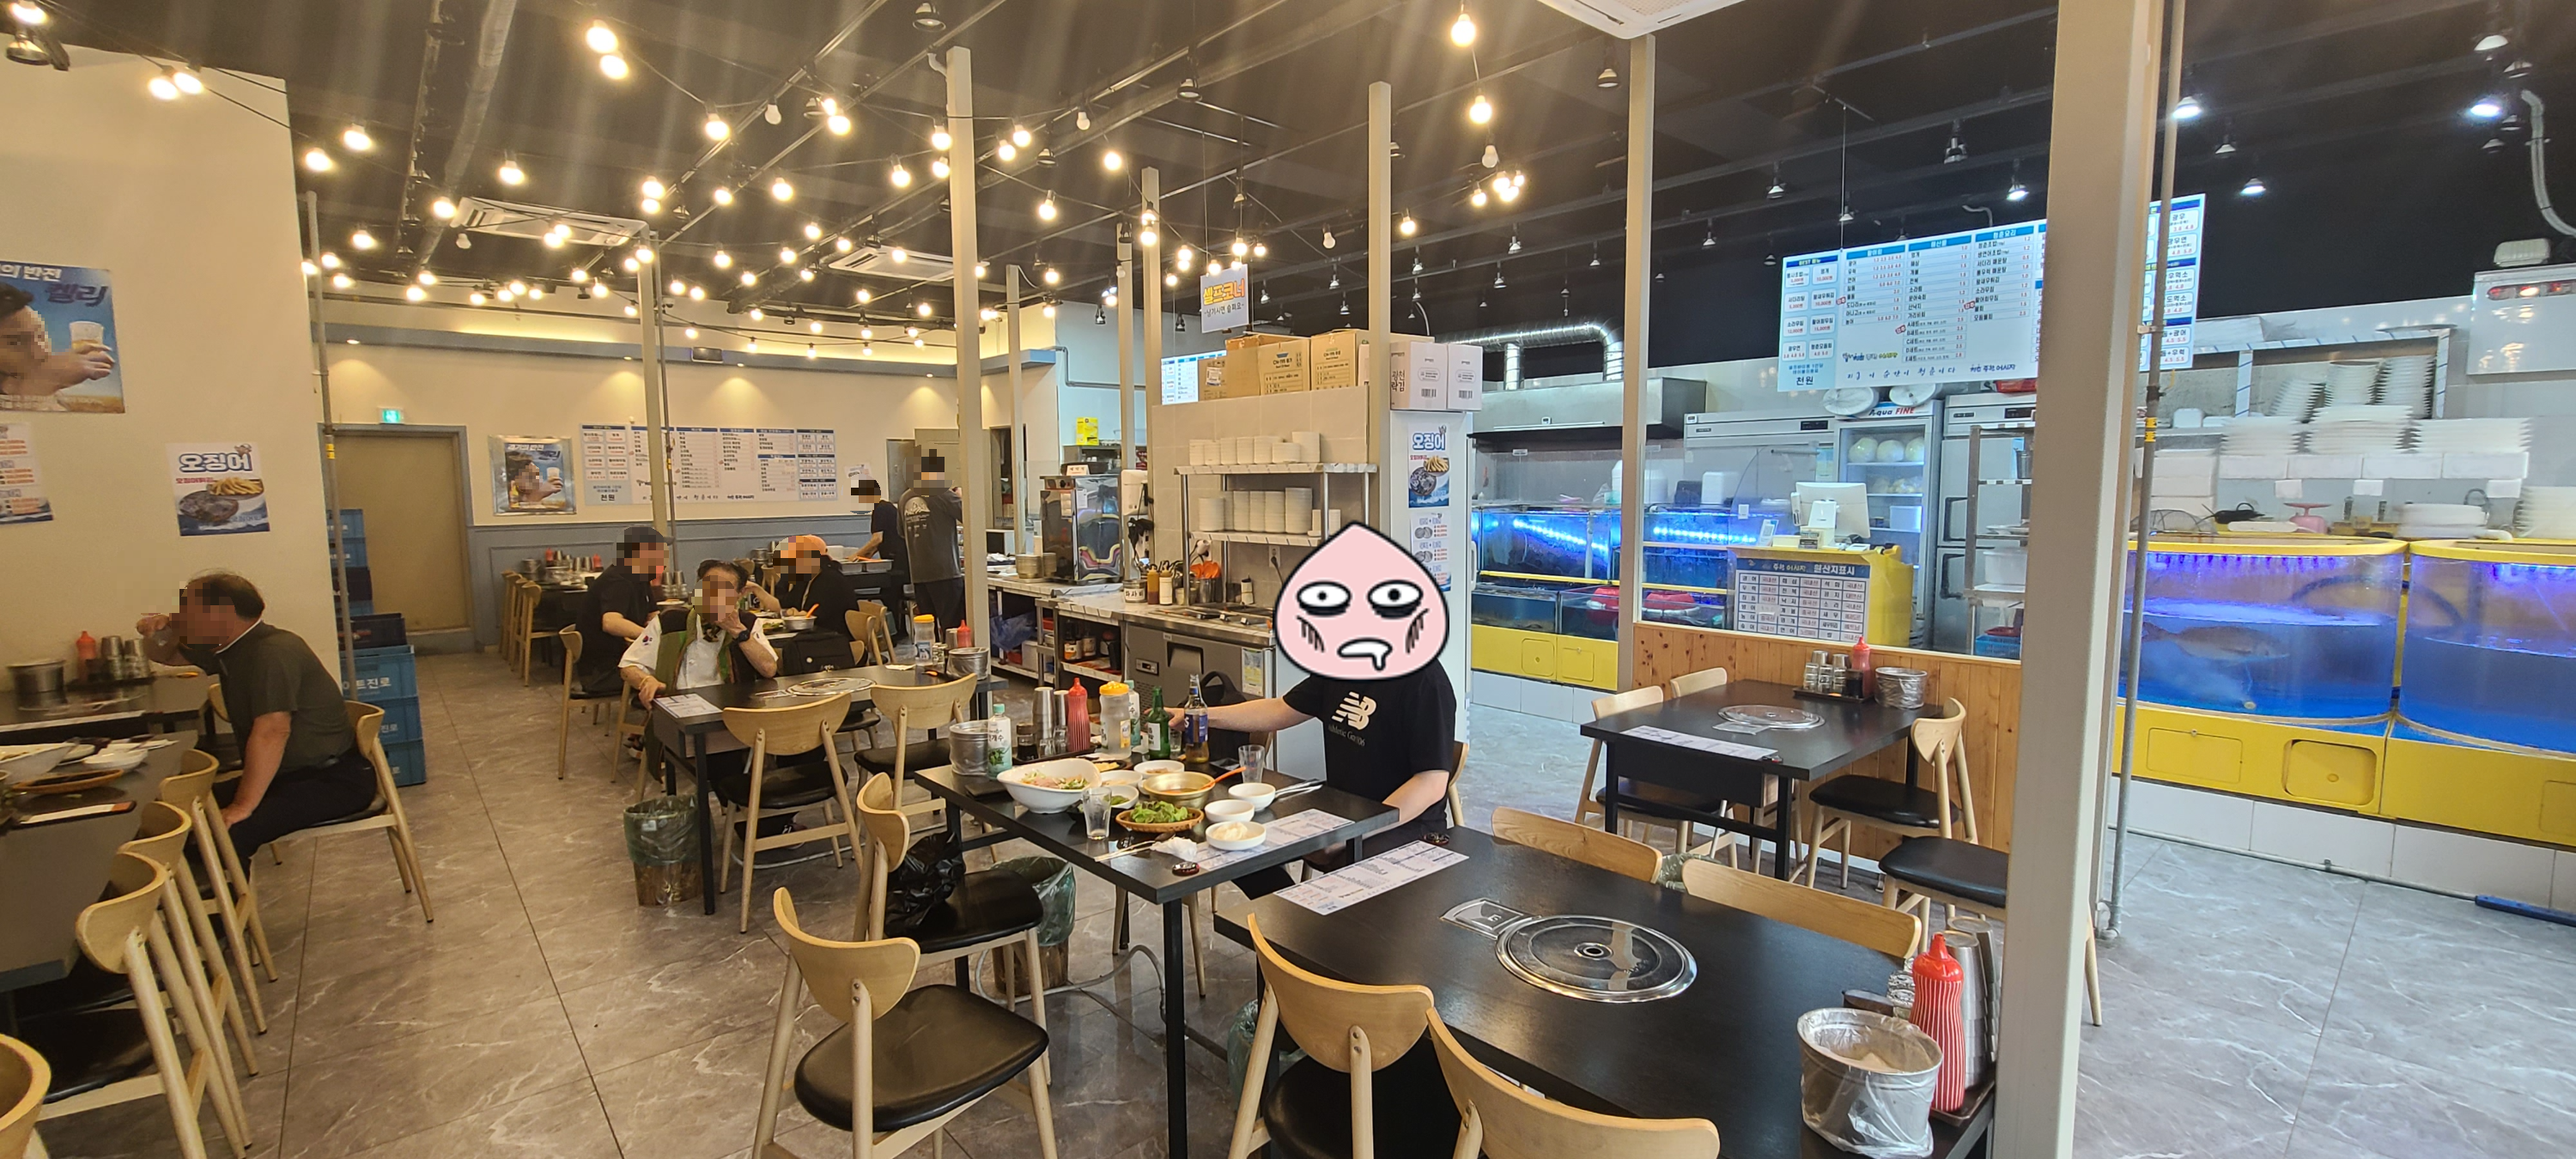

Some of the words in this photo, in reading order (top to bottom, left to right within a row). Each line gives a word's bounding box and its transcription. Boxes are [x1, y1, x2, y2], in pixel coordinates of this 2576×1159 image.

[24, 266, 62, 282] 반전
[46, 283, 108, 307] 켈리
[1203, 278, 1245, 306] 셀프코너
[1796, 376, 1814, 385] 천원
[1895, 406, 1916, 415] FINE
[1412, 433, 1446, 451] 오징어
[179, 452, 252, 473] 오징어
[1814, 564, 1855, 575] 원산지표시
